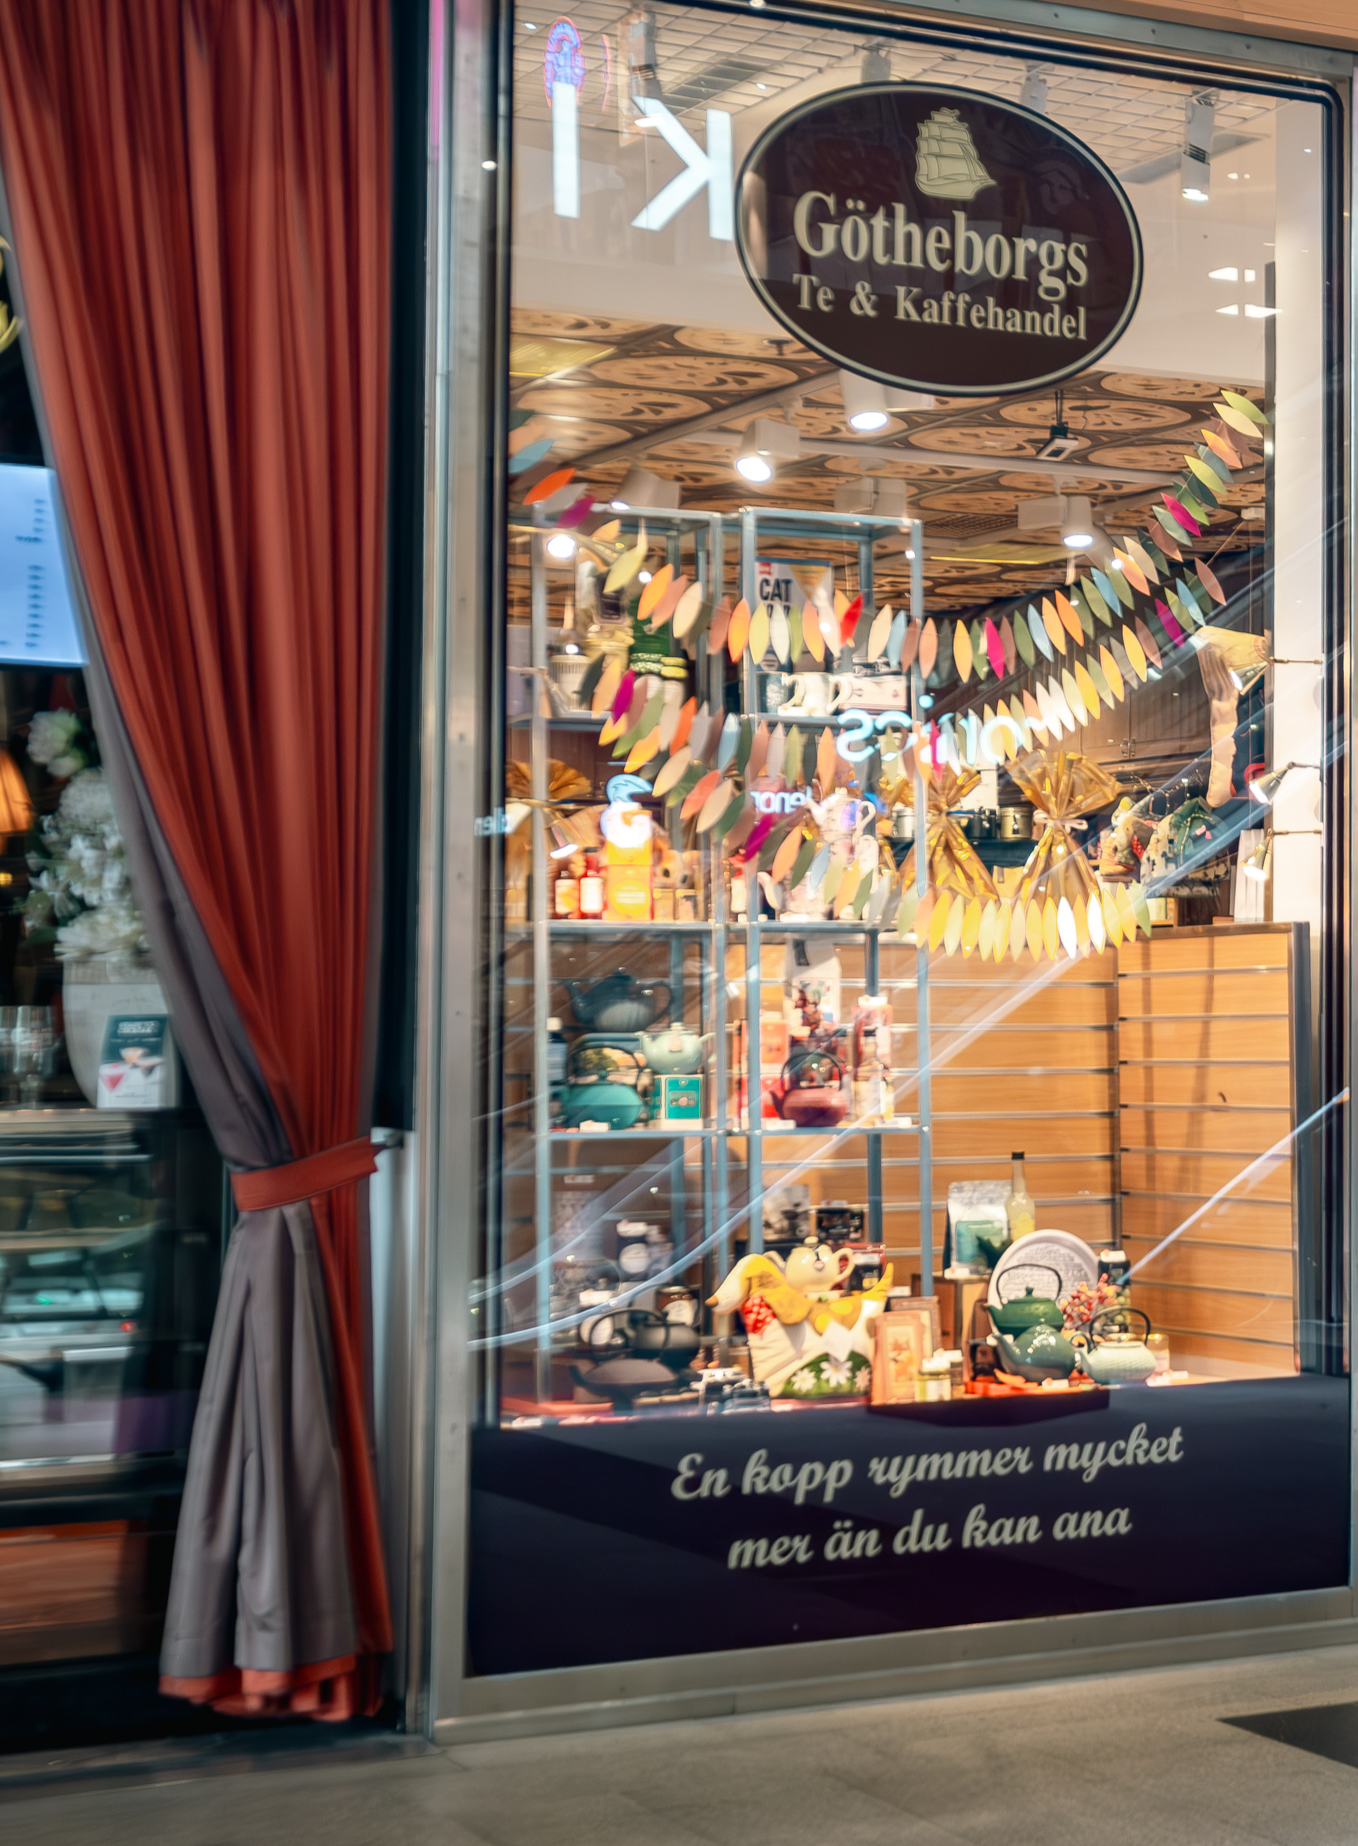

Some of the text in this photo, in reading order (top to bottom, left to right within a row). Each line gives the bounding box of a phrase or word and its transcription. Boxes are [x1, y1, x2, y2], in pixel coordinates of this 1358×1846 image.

[793, 190, 1088, 301] Götheborgs
[793, 273, 1087, 340] Te & Kaffehandel
[760, 578, 792, 602] CAT
[671, 1422, 1184, 1505] En kopp rymmer mycket
[727, 1504, 1132, 1569] mer än du kan ana
